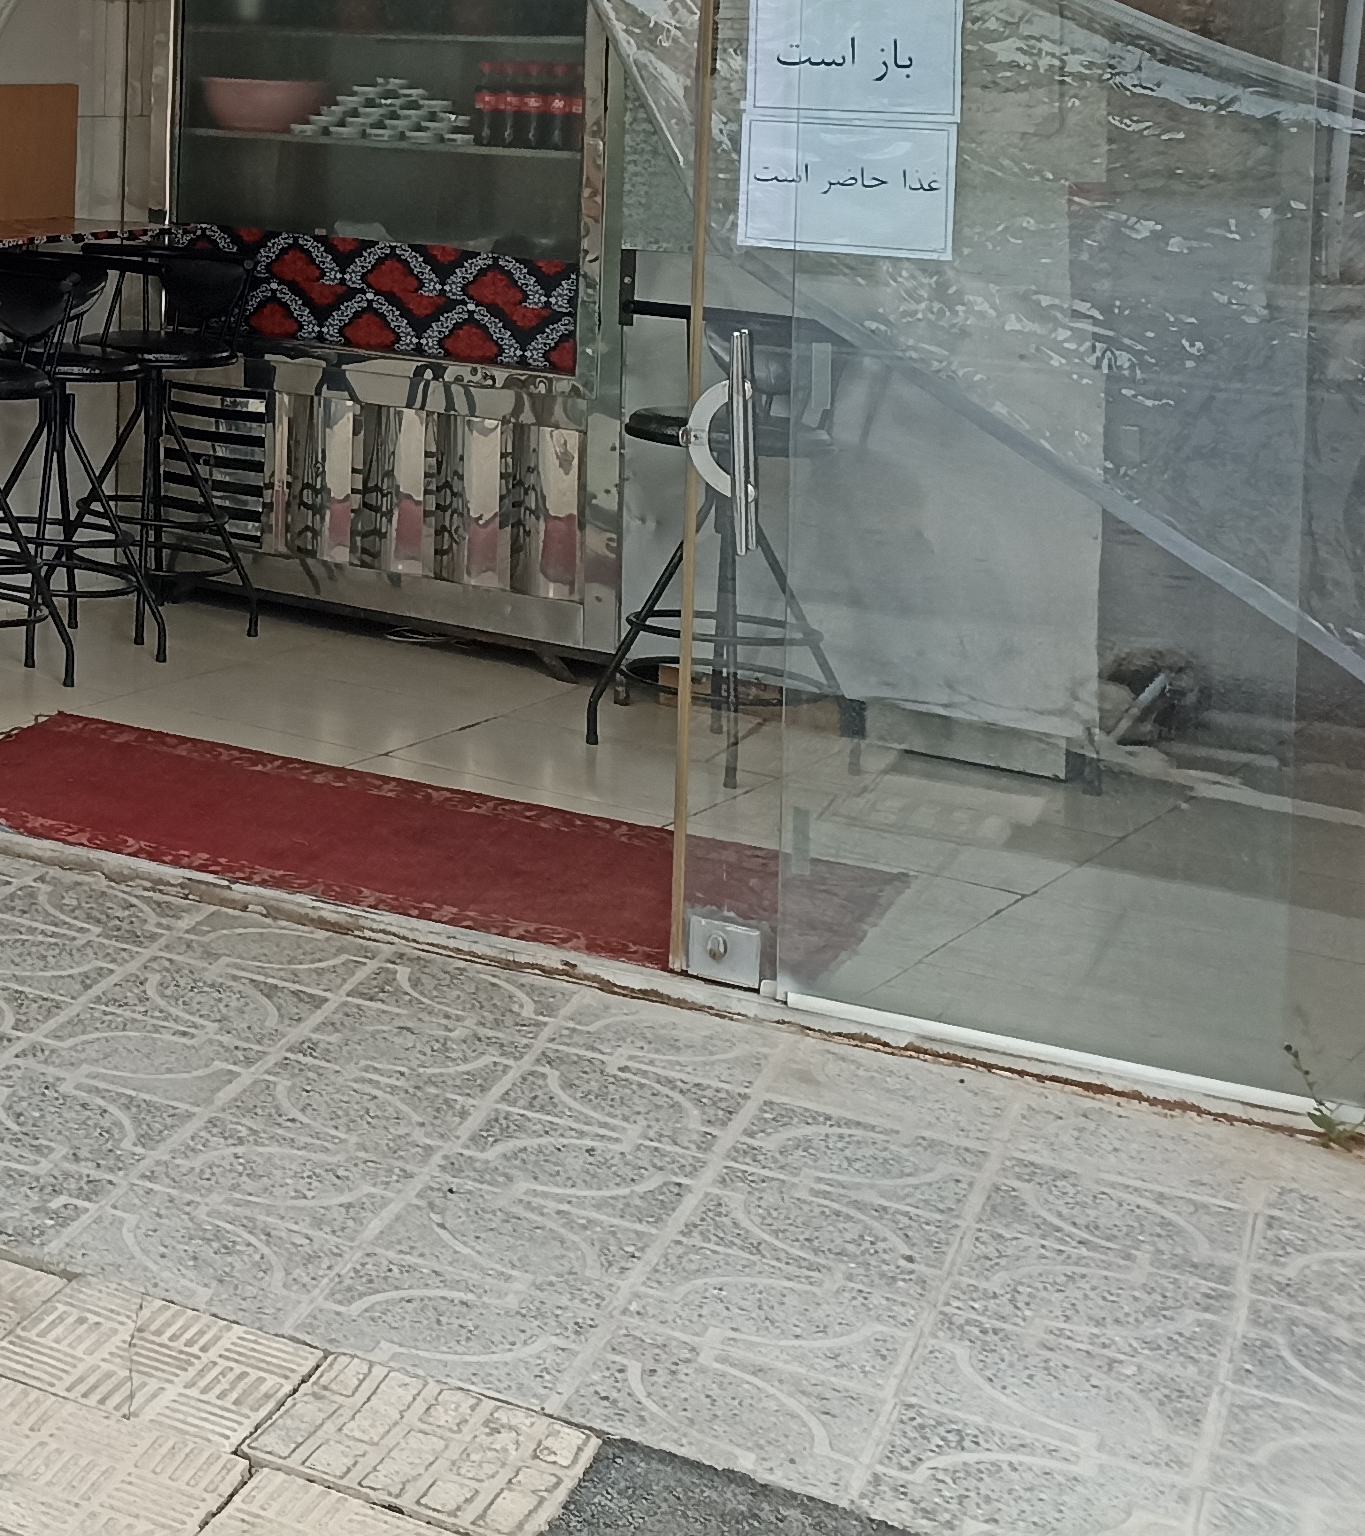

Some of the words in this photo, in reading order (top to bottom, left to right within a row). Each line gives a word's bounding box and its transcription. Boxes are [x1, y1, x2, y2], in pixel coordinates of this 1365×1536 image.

[776, 36, 856, 67] است
[872, 38, 913, 82] باز
[752, 163, 809, 184] است
[820, 166, 889, 196] حاضر
[902, 168, 943, 193] غذا
